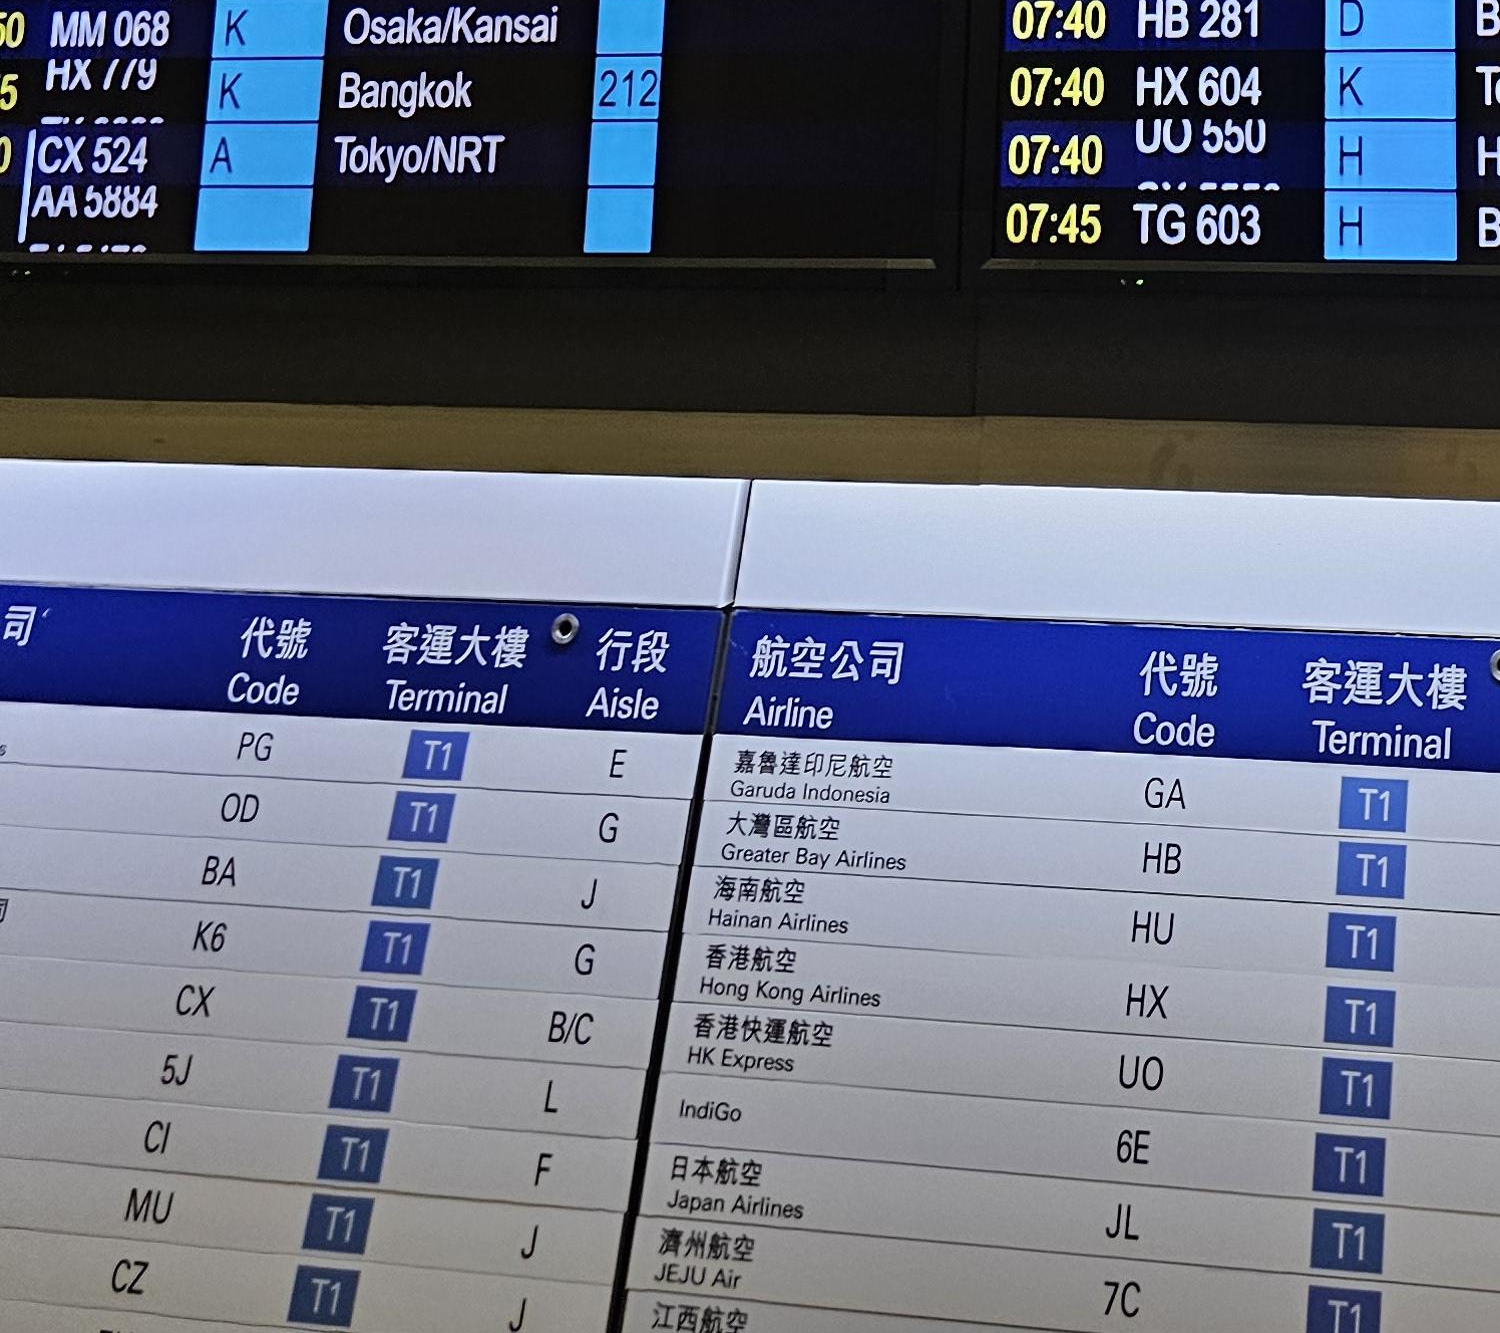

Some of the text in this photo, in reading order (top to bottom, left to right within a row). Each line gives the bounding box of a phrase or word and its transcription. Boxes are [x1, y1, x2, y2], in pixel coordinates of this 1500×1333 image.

[1012, 0, 1107, 40] 07:40
[338, 69, 658, 119] Bangkok 212
[1006, 202, 1102, 245] 07:45
[1132, 203, 1186, 246] TG
[1196, 203, 1261, 246] 603
[240, 616, 313, 660] 代號
[382, 621, 530, 669] 客運大樓
[595, 627, 671, 673] 行段
[749, 634, 904, 685] 航空公司
[1139, 650, 1219, 698] 代號
[227, 671, 300, 706] Code
[385, 678, 509, 715] Terminal
[585, 686, 660, 720] Aisle
[742, 695, 834, 730] Airline
[1133, 711, 1215, 748] Code
[236, 731, 628, 779] PG T1 E
[733, 749, 893, 779] 嘉魯達印尼航空
[730, 779, 891, 804] Garuda Indonesia
[1144, 777, 1186, 810] GA
[1358, 787, 1390, 822] T1
[705, 943, 797, 974] 香港航空
[699, 976, 881, 1008] Hong Kong Airlines
[1125, 982, 1169, 1020] HX
[175, 984, 594, 1046] CX B/C
